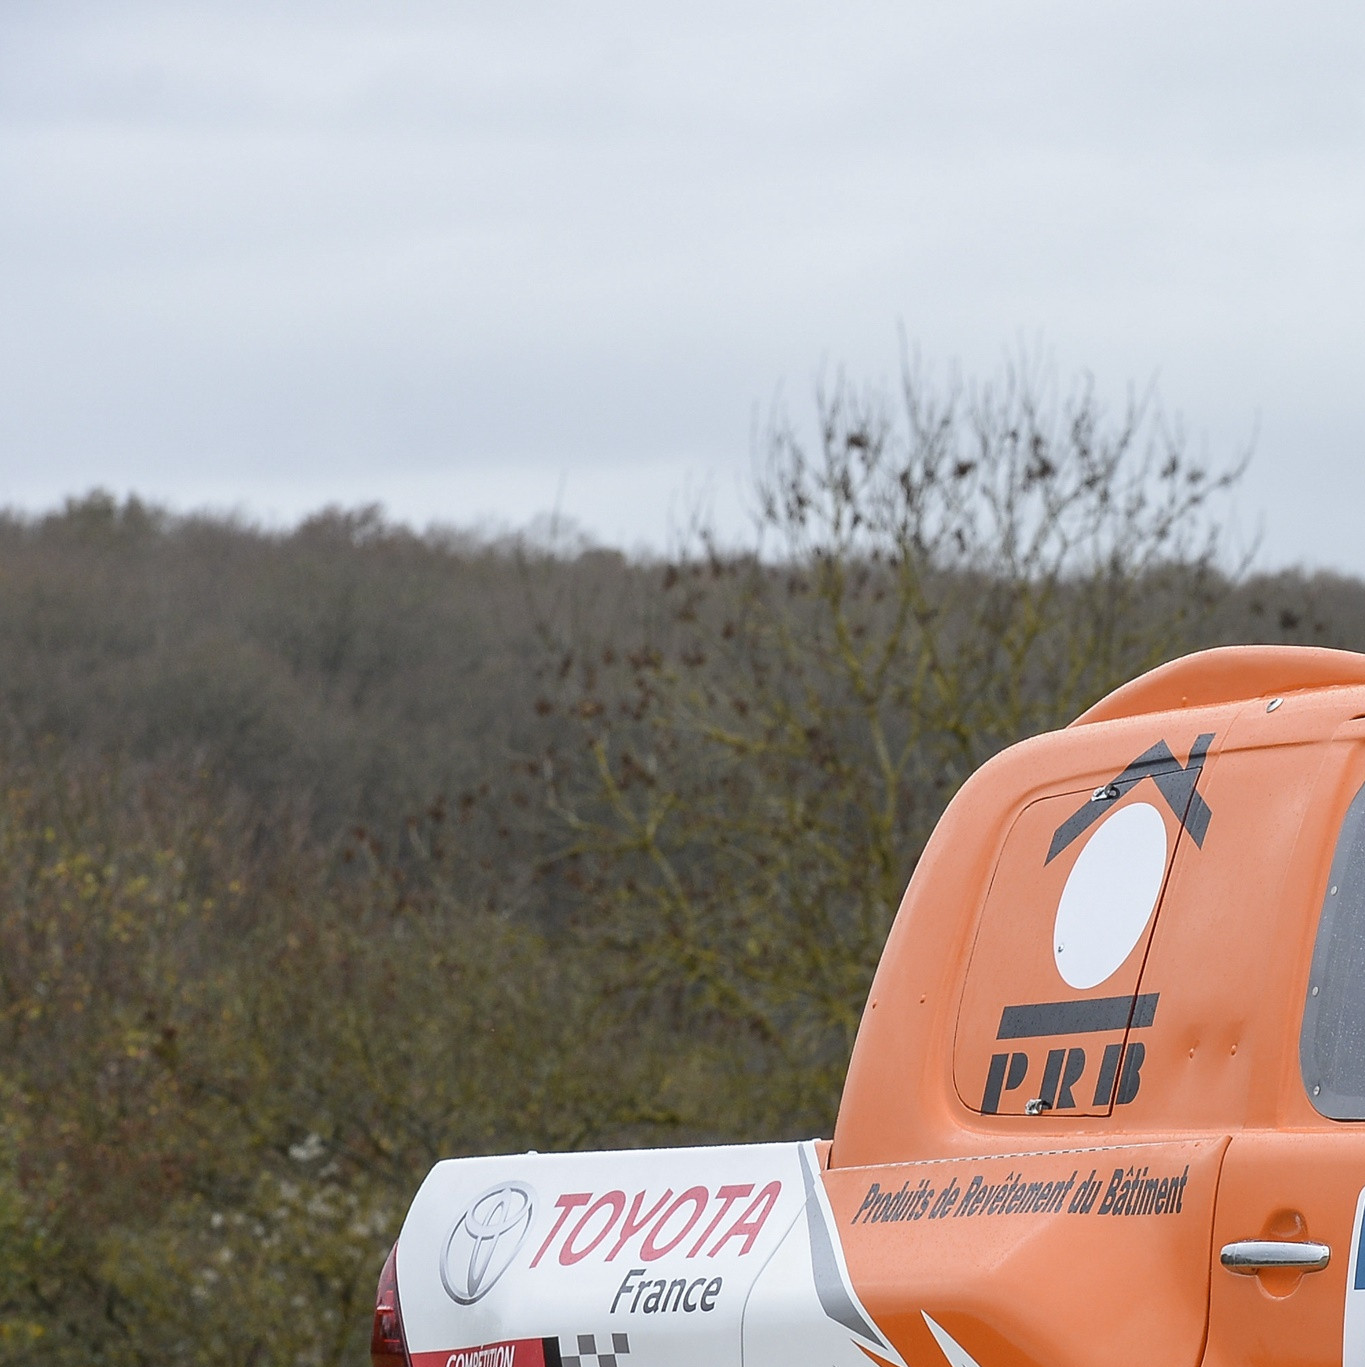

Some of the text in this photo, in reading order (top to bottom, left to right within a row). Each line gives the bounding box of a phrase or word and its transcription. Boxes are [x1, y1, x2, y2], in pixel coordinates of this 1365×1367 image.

[980, 1043, 1146, 1116] PRB
[528, 1180, 782, 1269] TOYOTA
[850, 1164, 1191, 1225] Produits de Revêtement du Bâtiment
[609, 1268, 723, 1314] France
